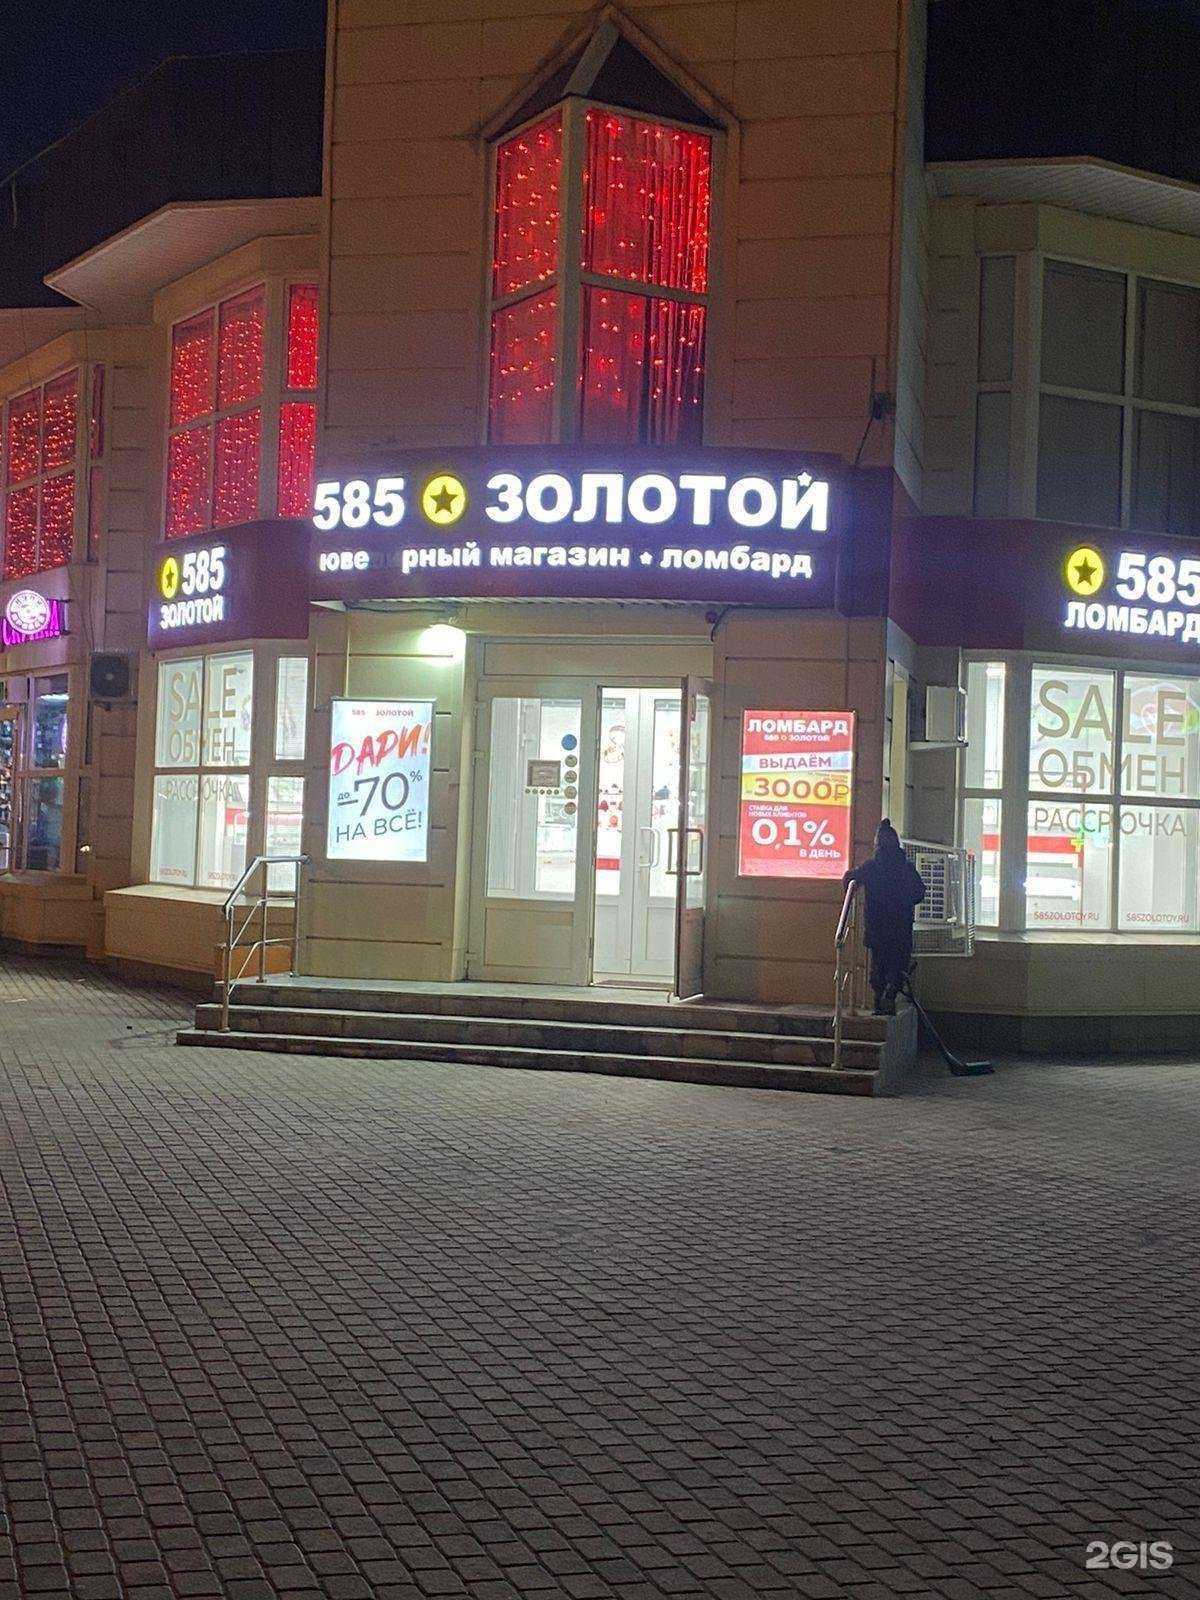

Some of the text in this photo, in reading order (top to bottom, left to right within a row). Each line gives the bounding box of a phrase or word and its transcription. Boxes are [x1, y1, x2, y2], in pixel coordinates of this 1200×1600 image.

[312, 472, 830, 532] 585 ЗОЛОТОЙ
[181, 546, 225, 595] 585
[489, 544, 630, 569] магазин
[659, 545, 813, 578] ломбард
[1115, 552, 1200, 608] 585
[160, 593, 224, 629] ЗОЛОТОЙ
[1063, 600, 1200, 643] ЛОМБАРД
[170, 668, 238, 724] SALE
[1037, 679, 1187, 746] SALE
[747, 718, 849, 736] ЛОМБАРД
[759, 754, 832, 770] ВЫДАЁМ
[1038, 748, 1186, 793] ОБМЕН
[336, 808, 423, 843] НА ВСЁ!
[751, 818, 836, 849] 0,1%
[1034, 807, 1187, 837] РАССРОЧКА
[799, 849, 841, 859] В ДЕНЬ
